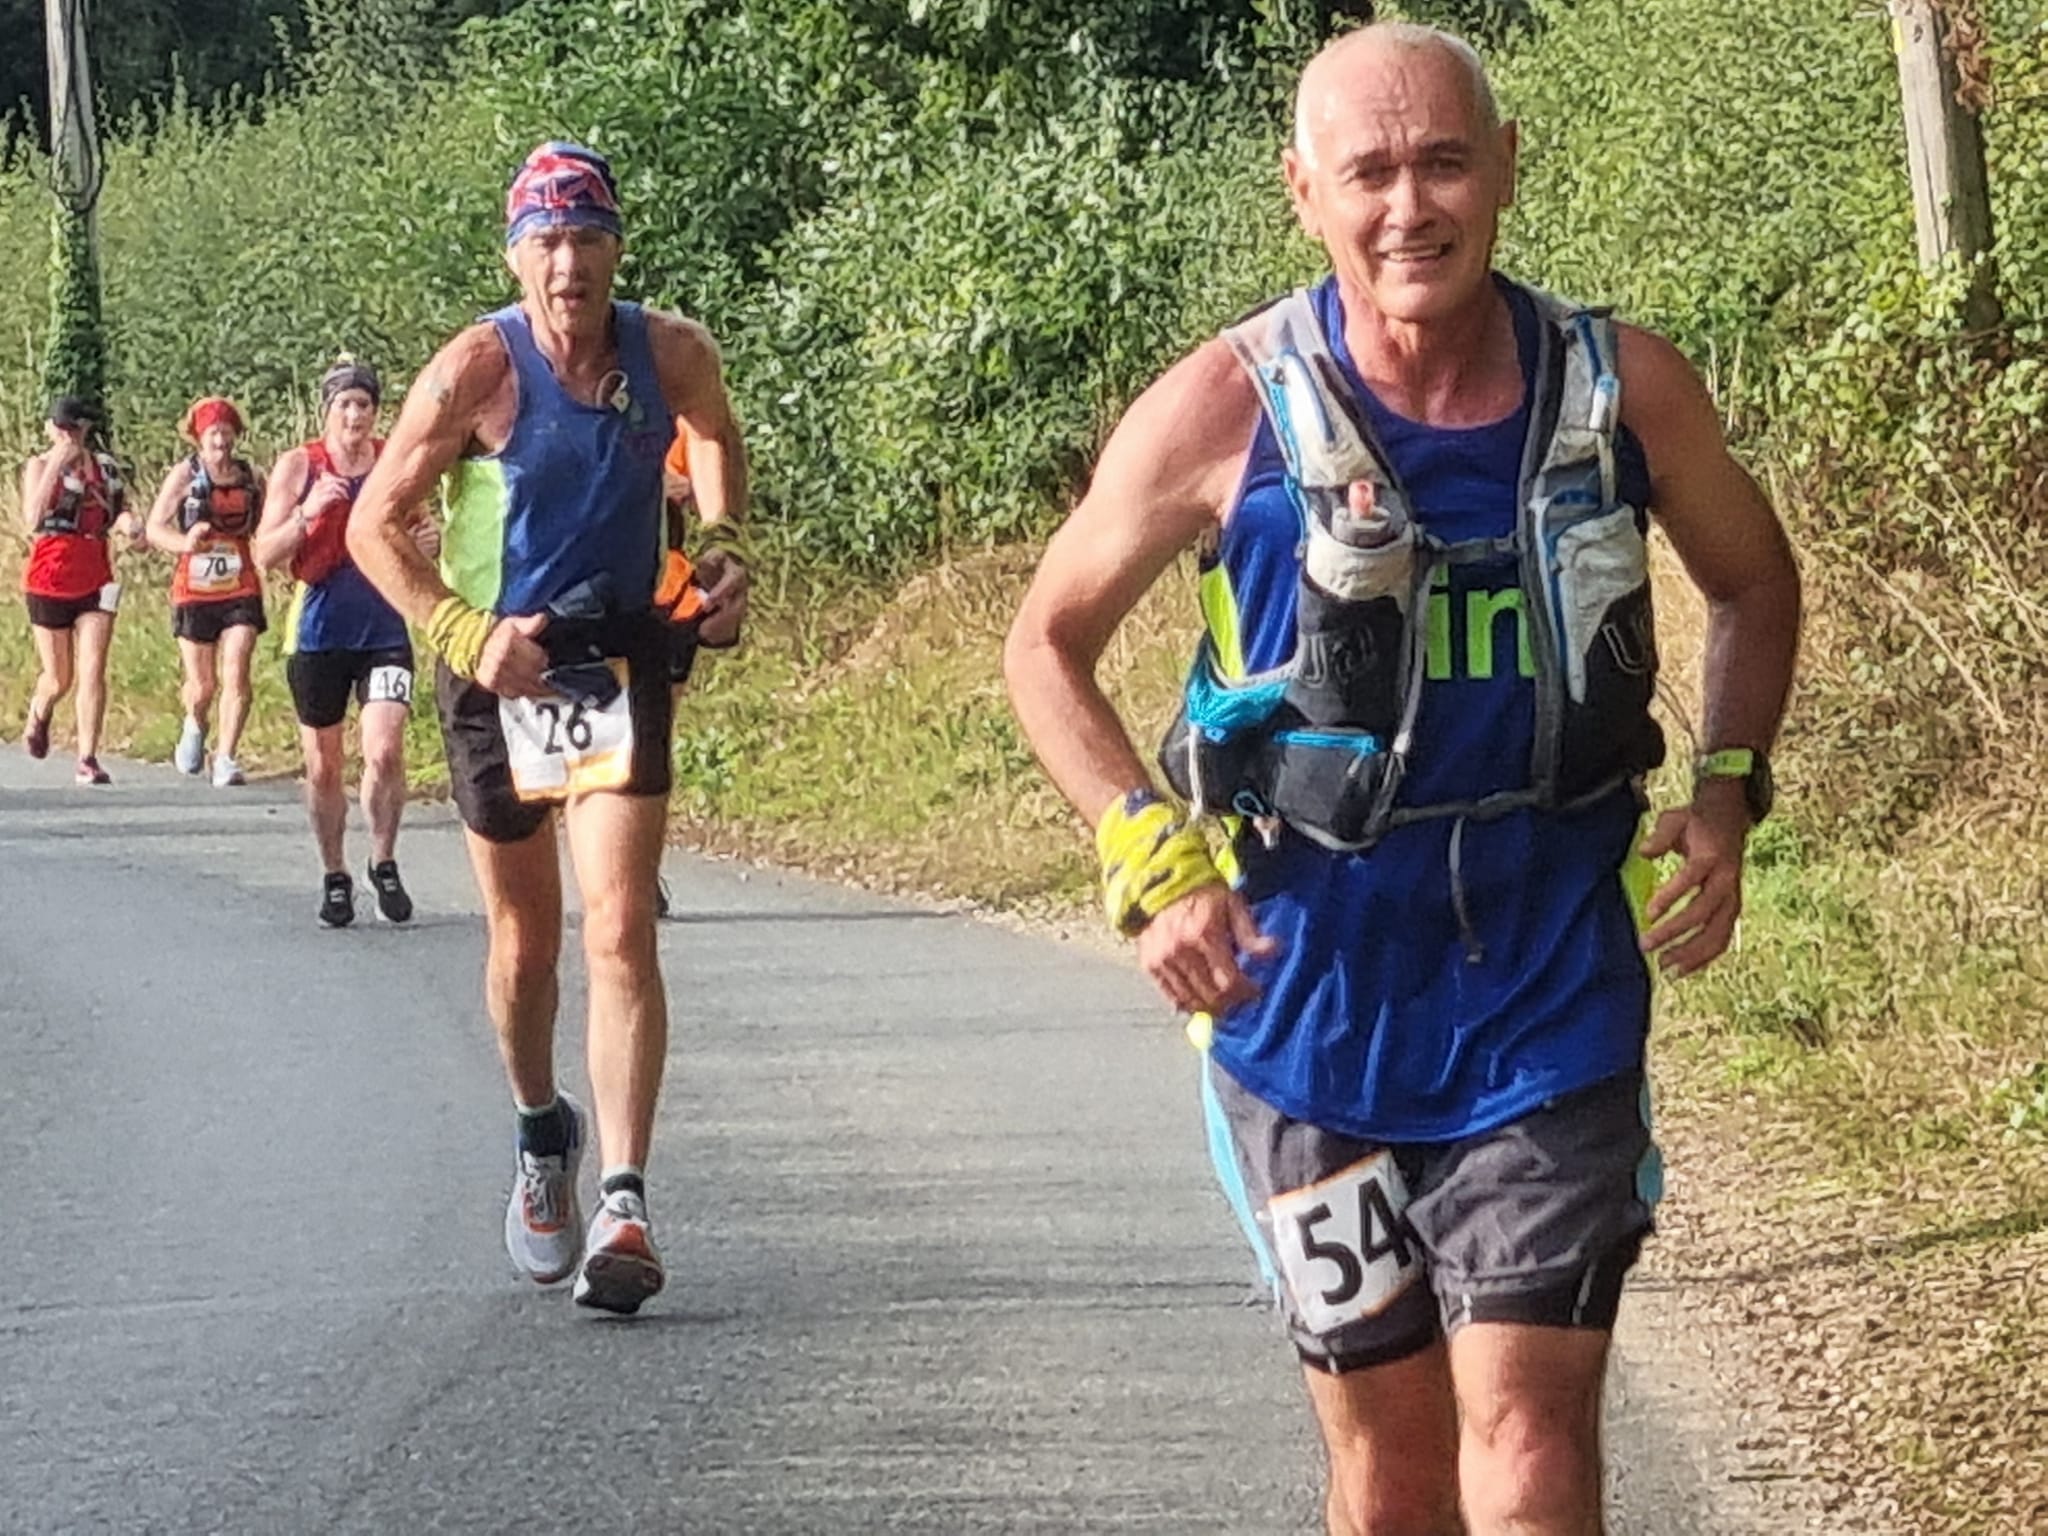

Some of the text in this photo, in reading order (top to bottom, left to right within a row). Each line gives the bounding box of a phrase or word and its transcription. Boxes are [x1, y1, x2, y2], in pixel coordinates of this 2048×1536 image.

[204, 556, 228, 577] 70
[377, 671, 406, 700] 46
[536, 700, 593, 755] 26
[1297, 1176, 1413, 1306] 54
